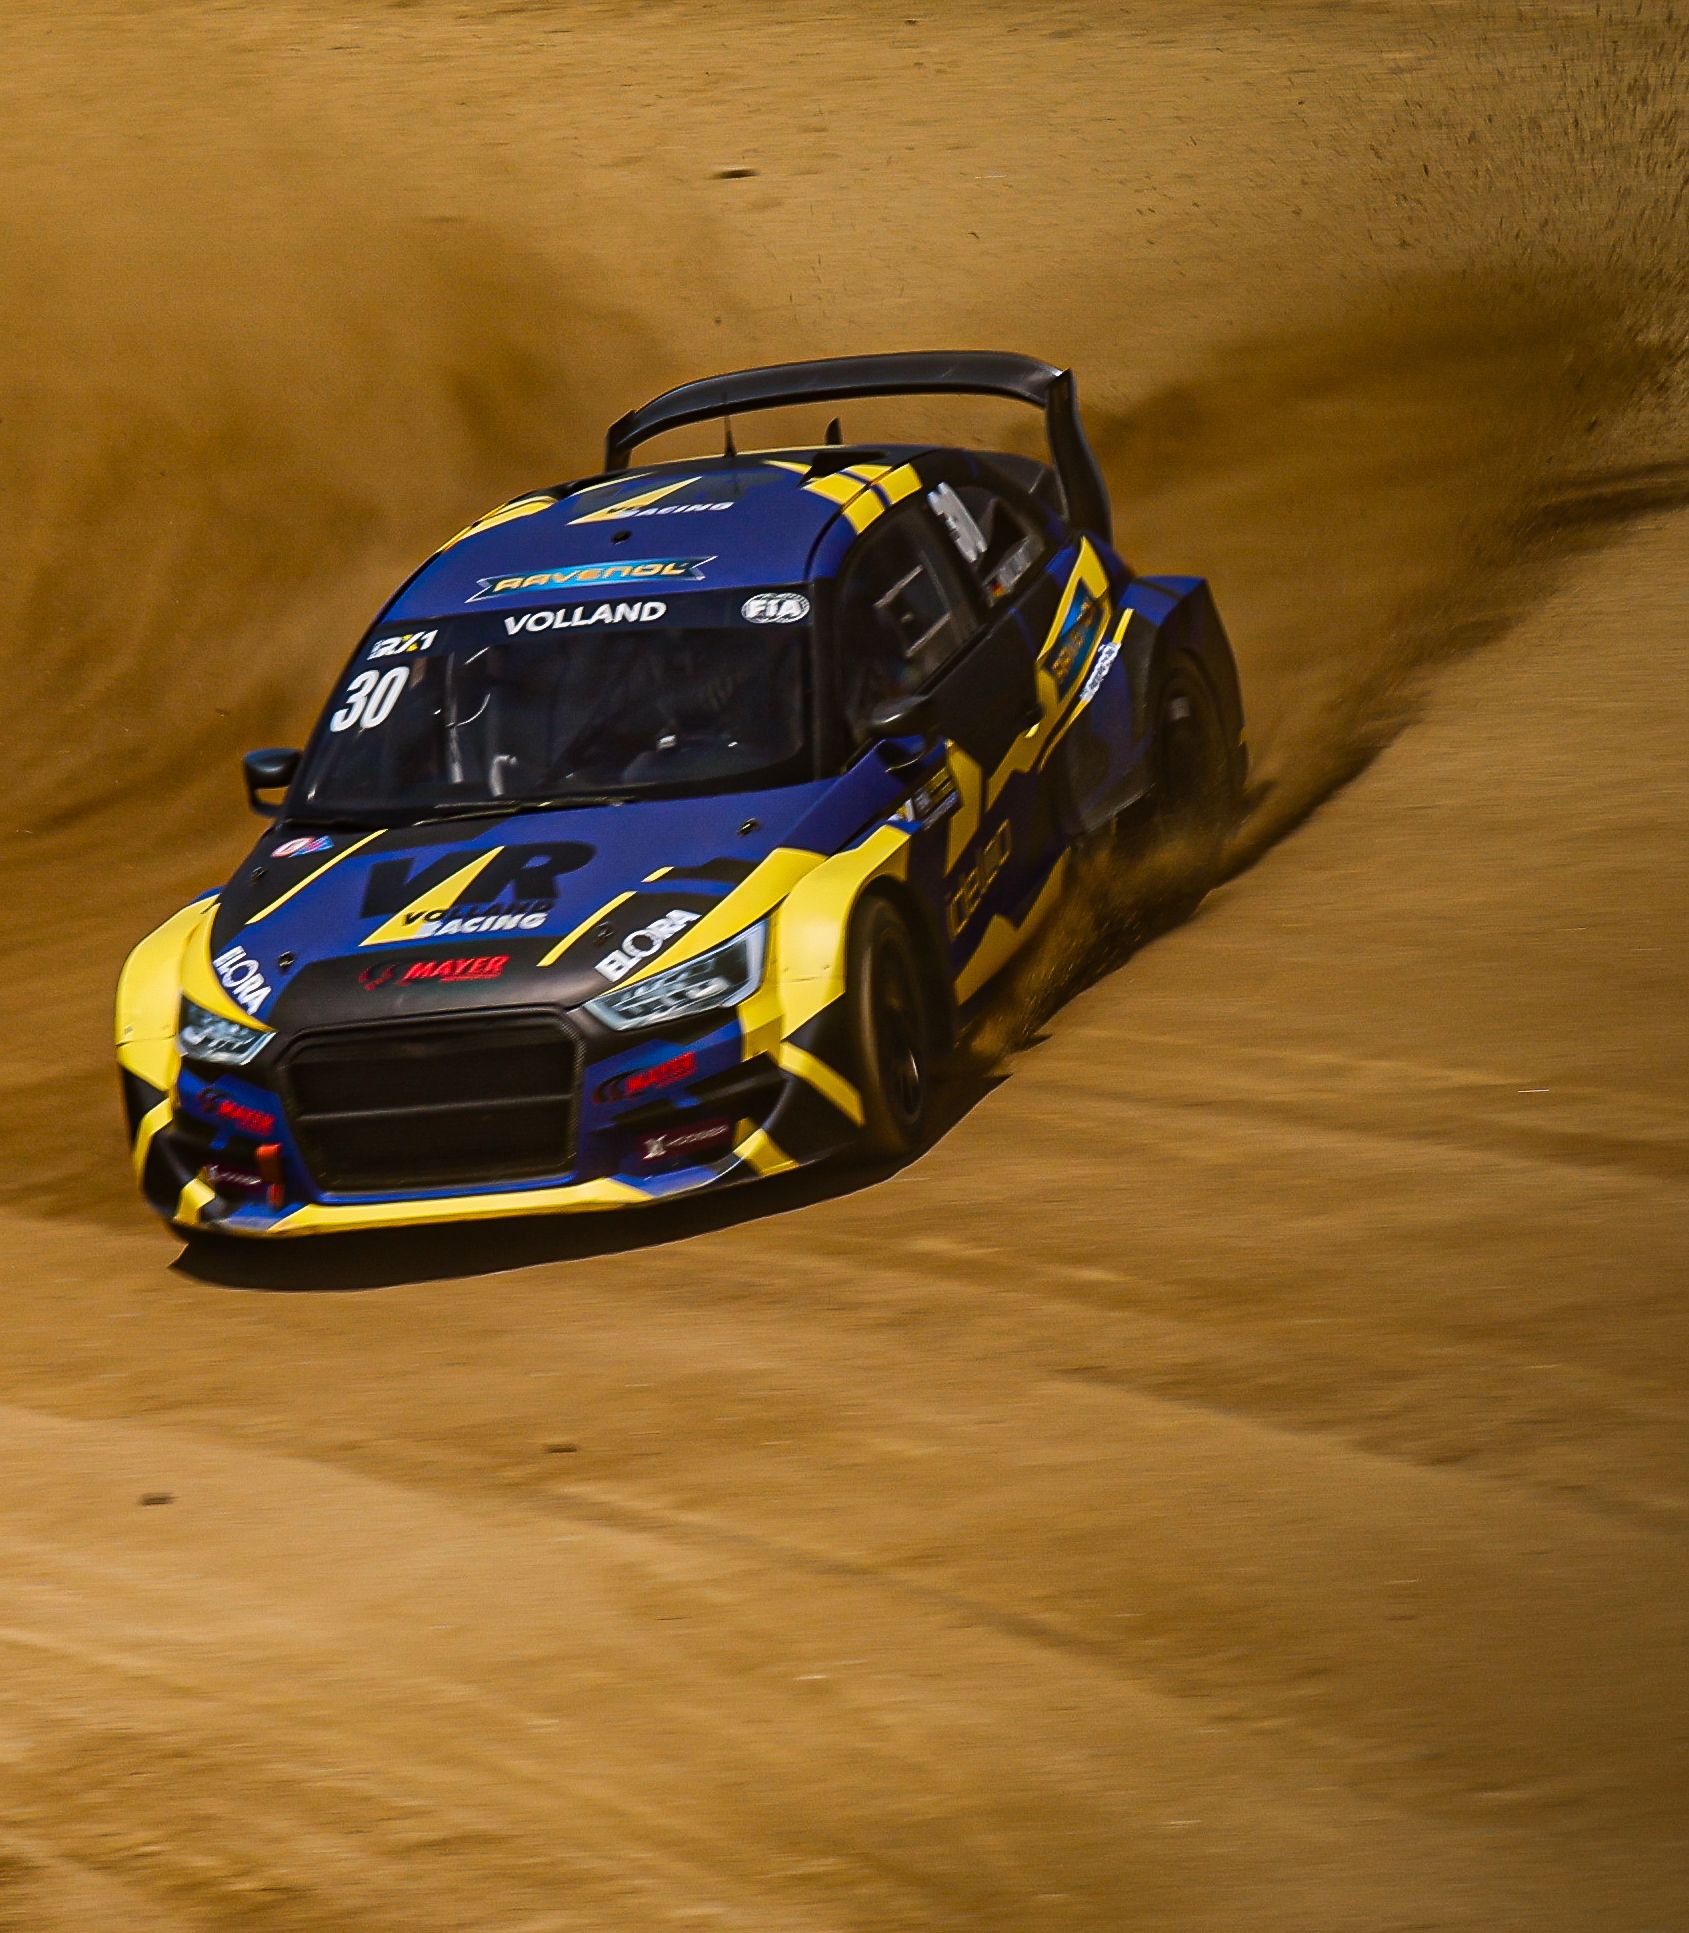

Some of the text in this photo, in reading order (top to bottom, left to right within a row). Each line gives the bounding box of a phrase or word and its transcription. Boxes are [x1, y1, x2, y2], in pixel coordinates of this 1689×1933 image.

[491, 561, 687, 593] RAVENOL
[503, 601, 667, 636] VOLLAND
[329, 665, 410, 733] 30
[594, 909, 702, 983] ELORA
[402, 955, 511, 981] MAYER
